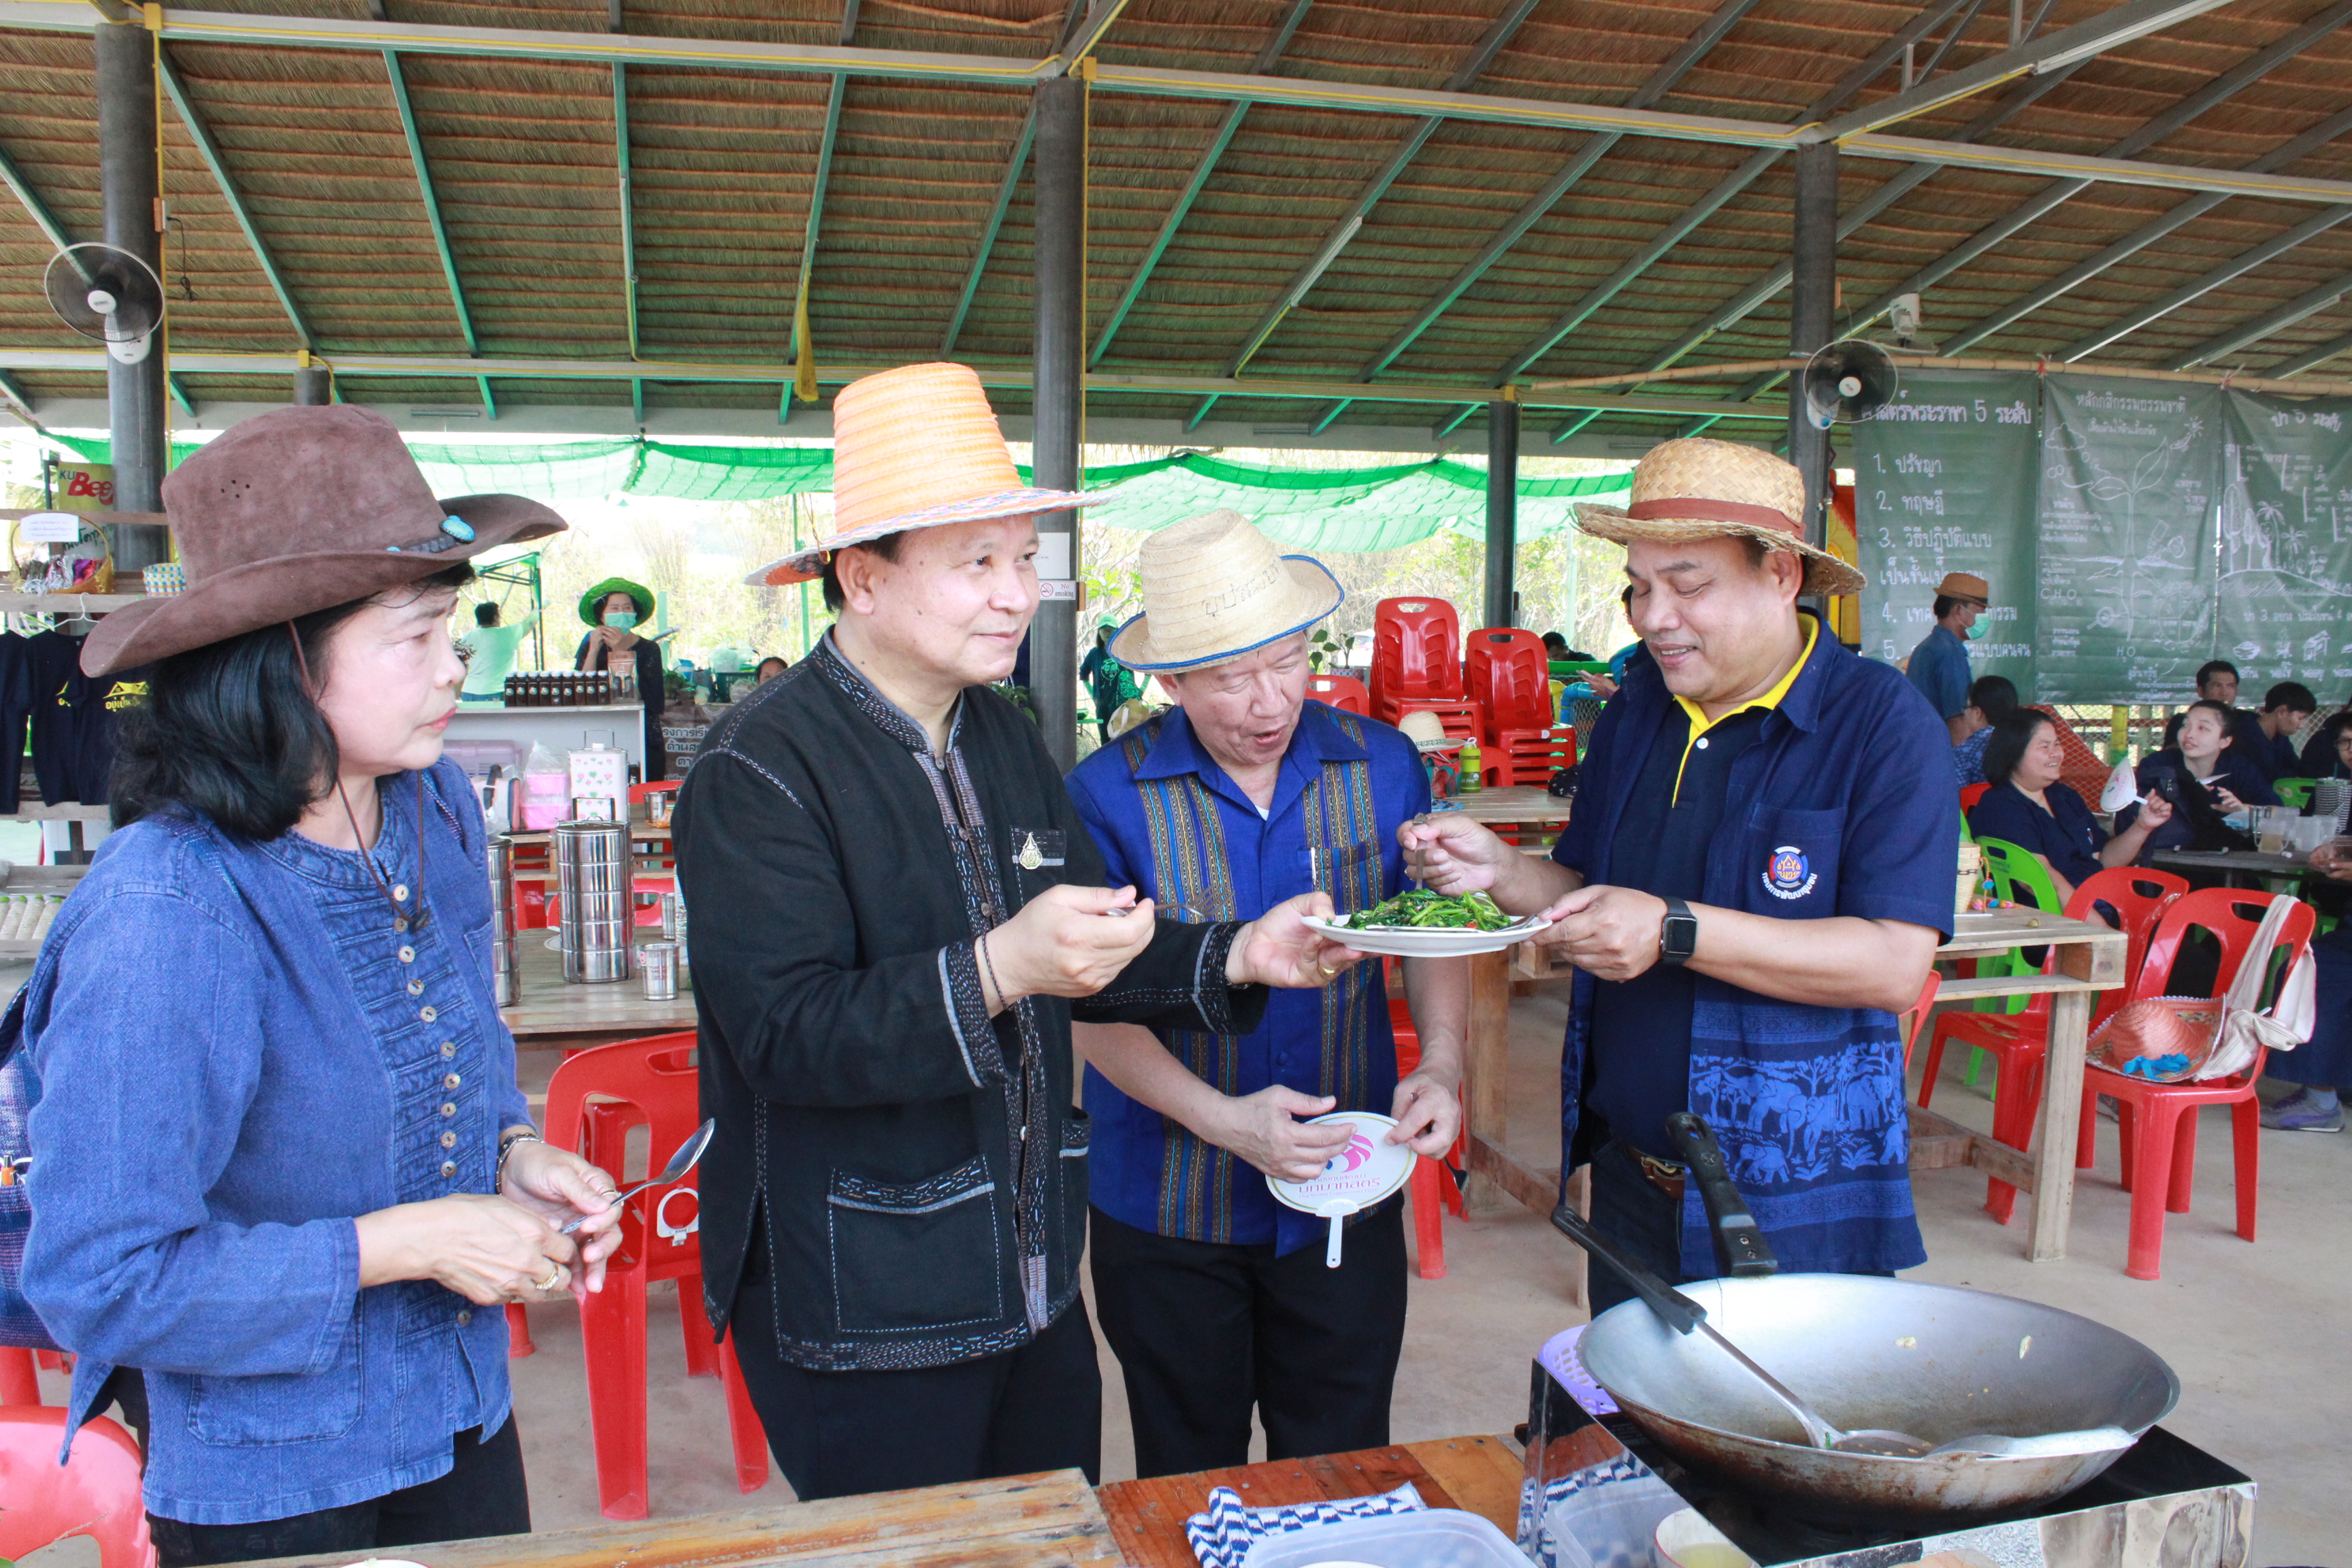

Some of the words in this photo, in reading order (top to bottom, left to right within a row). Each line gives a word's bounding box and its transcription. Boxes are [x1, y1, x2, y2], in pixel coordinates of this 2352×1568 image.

[1974, 399, 1987, 422] 5
[1995, 400, 2031, 424] ระดับ
[2076, 390, 2186, 413] หลักกสิกรรมธรรมชาติ
[59, 470, 76, 480] KU
[1874, 453, 1886, 474] 1.
[1895, 453, 1942, 478] ปรัชญา
[67, 472, 114, 506] Bee
[1876, 490, 1893, 511] 2.
[1878, 527, 1896, 548] 3.
[1903, 526, 1992, 553] วิธีปฏิบัติแบบ
[1055, 590, 1074, 598] smoking
[1882, 602, 1897, 623] 4.
[2260, 609, 2268, 622] 3
[1882, 639, 1901, 660] 5.
[665, 738, 702, 753] ด้านส
[1761, 872, 1818, 900] กรมการพัฒนาชุมชน
[1298, 1177, 1381, 1193] บทบาทสตรี
